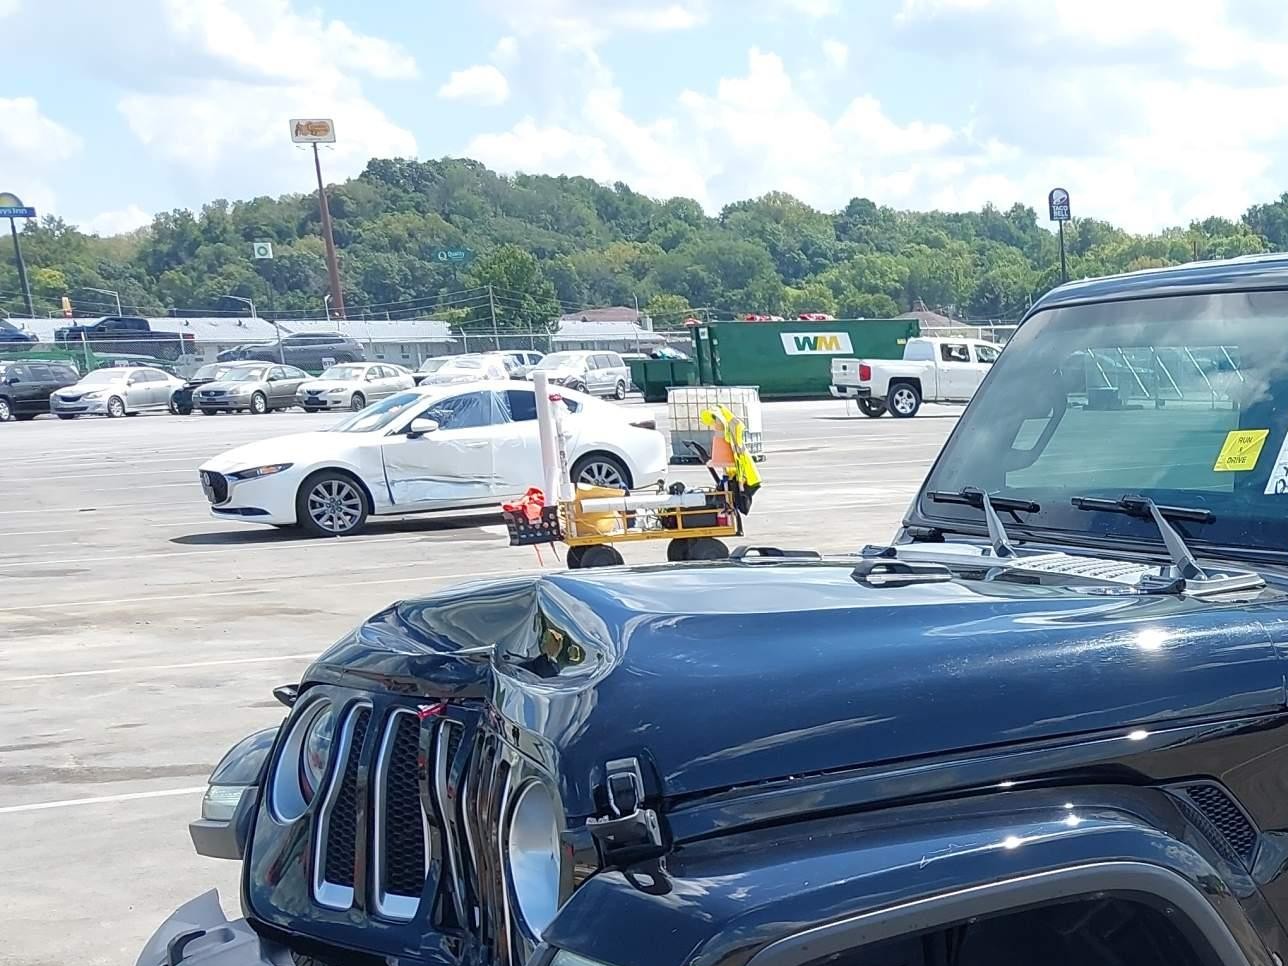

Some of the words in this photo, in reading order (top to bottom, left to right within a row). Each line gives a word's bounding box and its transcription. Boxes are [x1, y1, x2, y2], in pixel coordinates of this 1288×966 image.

[12, 207, 28, 215] Inn
[794, 335, 841, 351] WM
[1238, 436, 1254, 444] RUN
[1227, 456, 1247, 464] DRIVE
